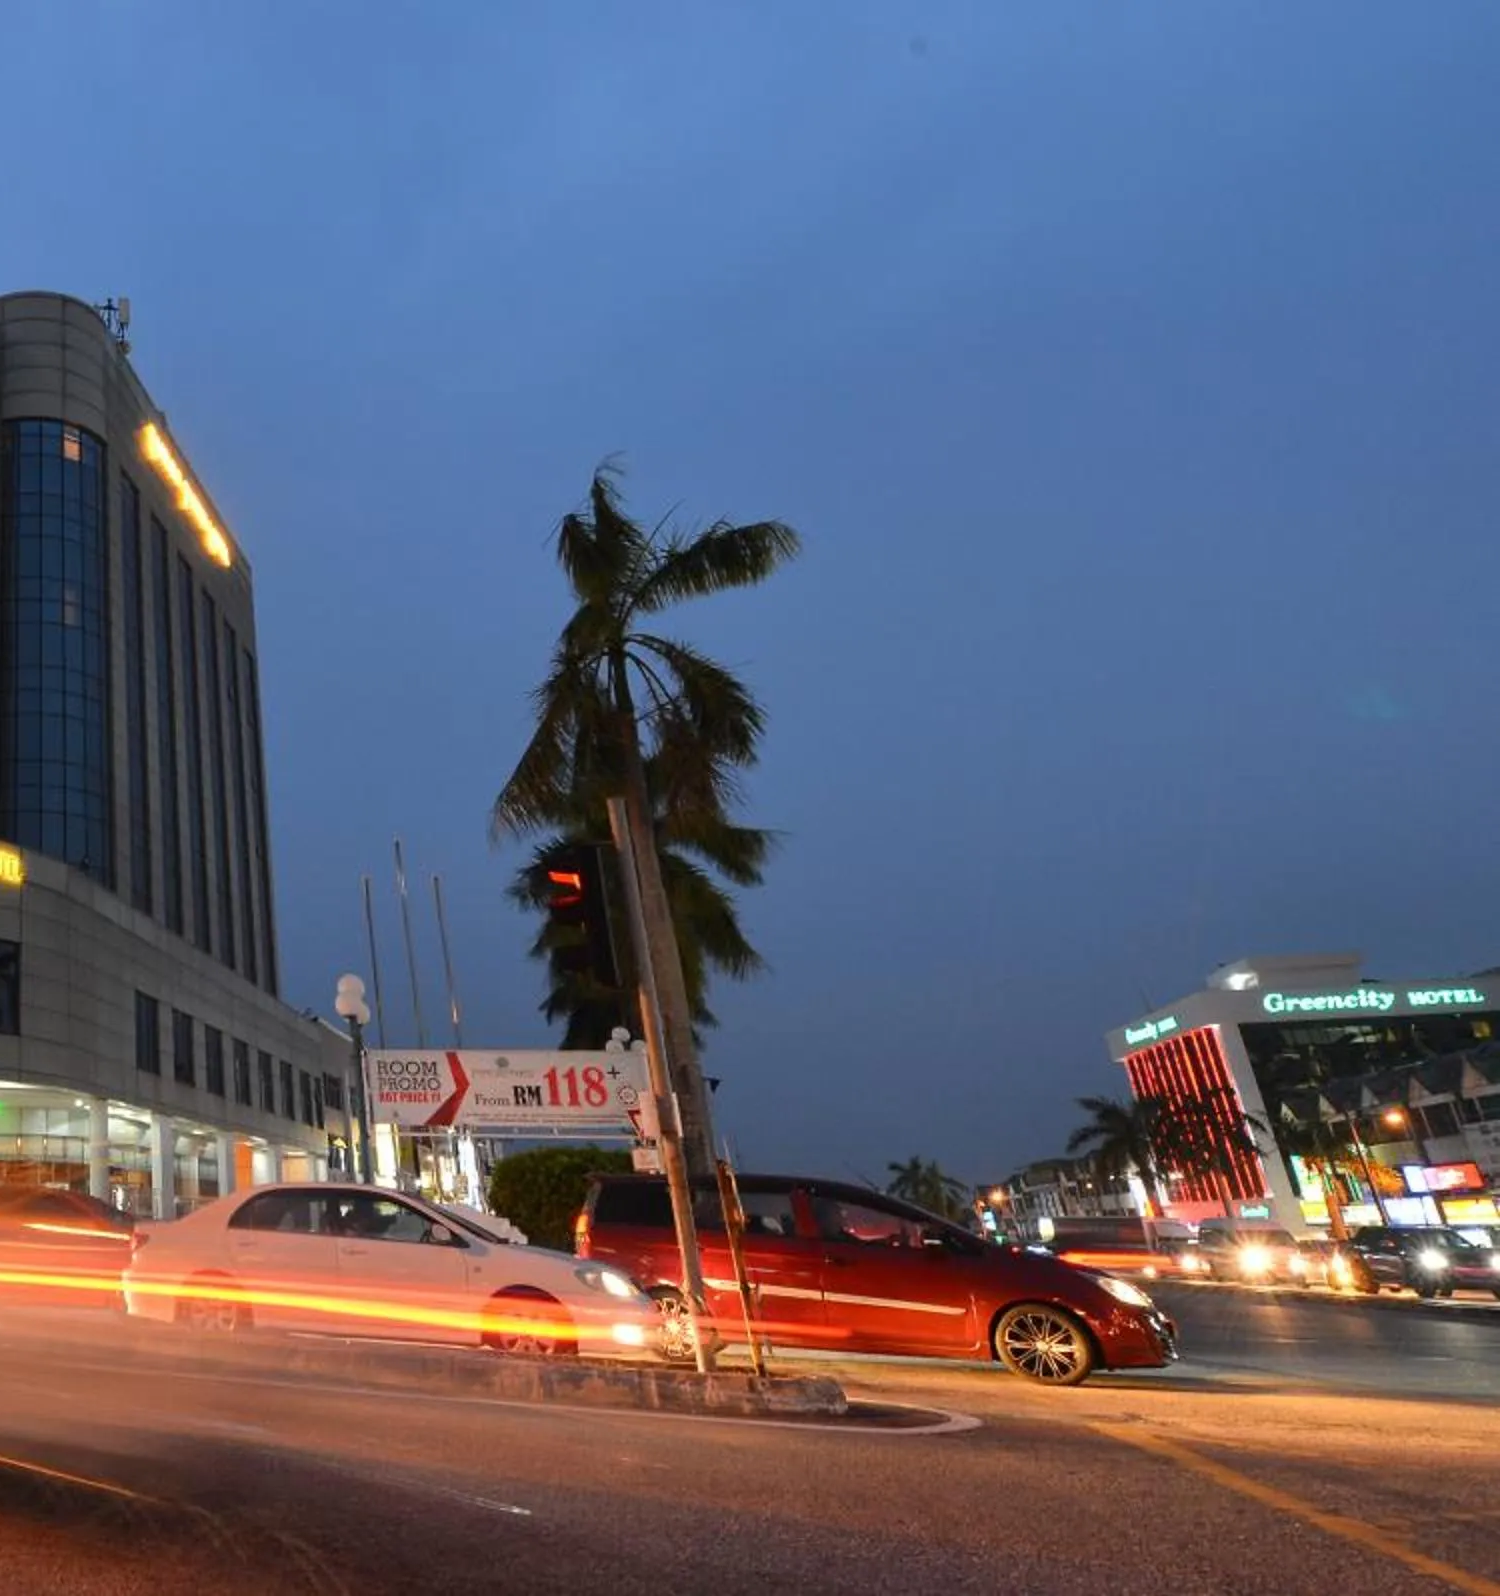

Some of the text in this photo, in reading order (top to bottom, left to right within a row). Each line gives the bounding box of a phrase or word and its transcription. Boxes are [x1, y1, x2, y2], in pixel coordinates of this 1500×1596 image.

[1263, 988, 1484, 1013] Greencity HOTEL
[377, 1060, 438, 1076] ROOM
[378, 1076, 441, 1091] PROMO
[474, 1093, 510, 1107] From
[512, 1085, 543, 1107] RM
